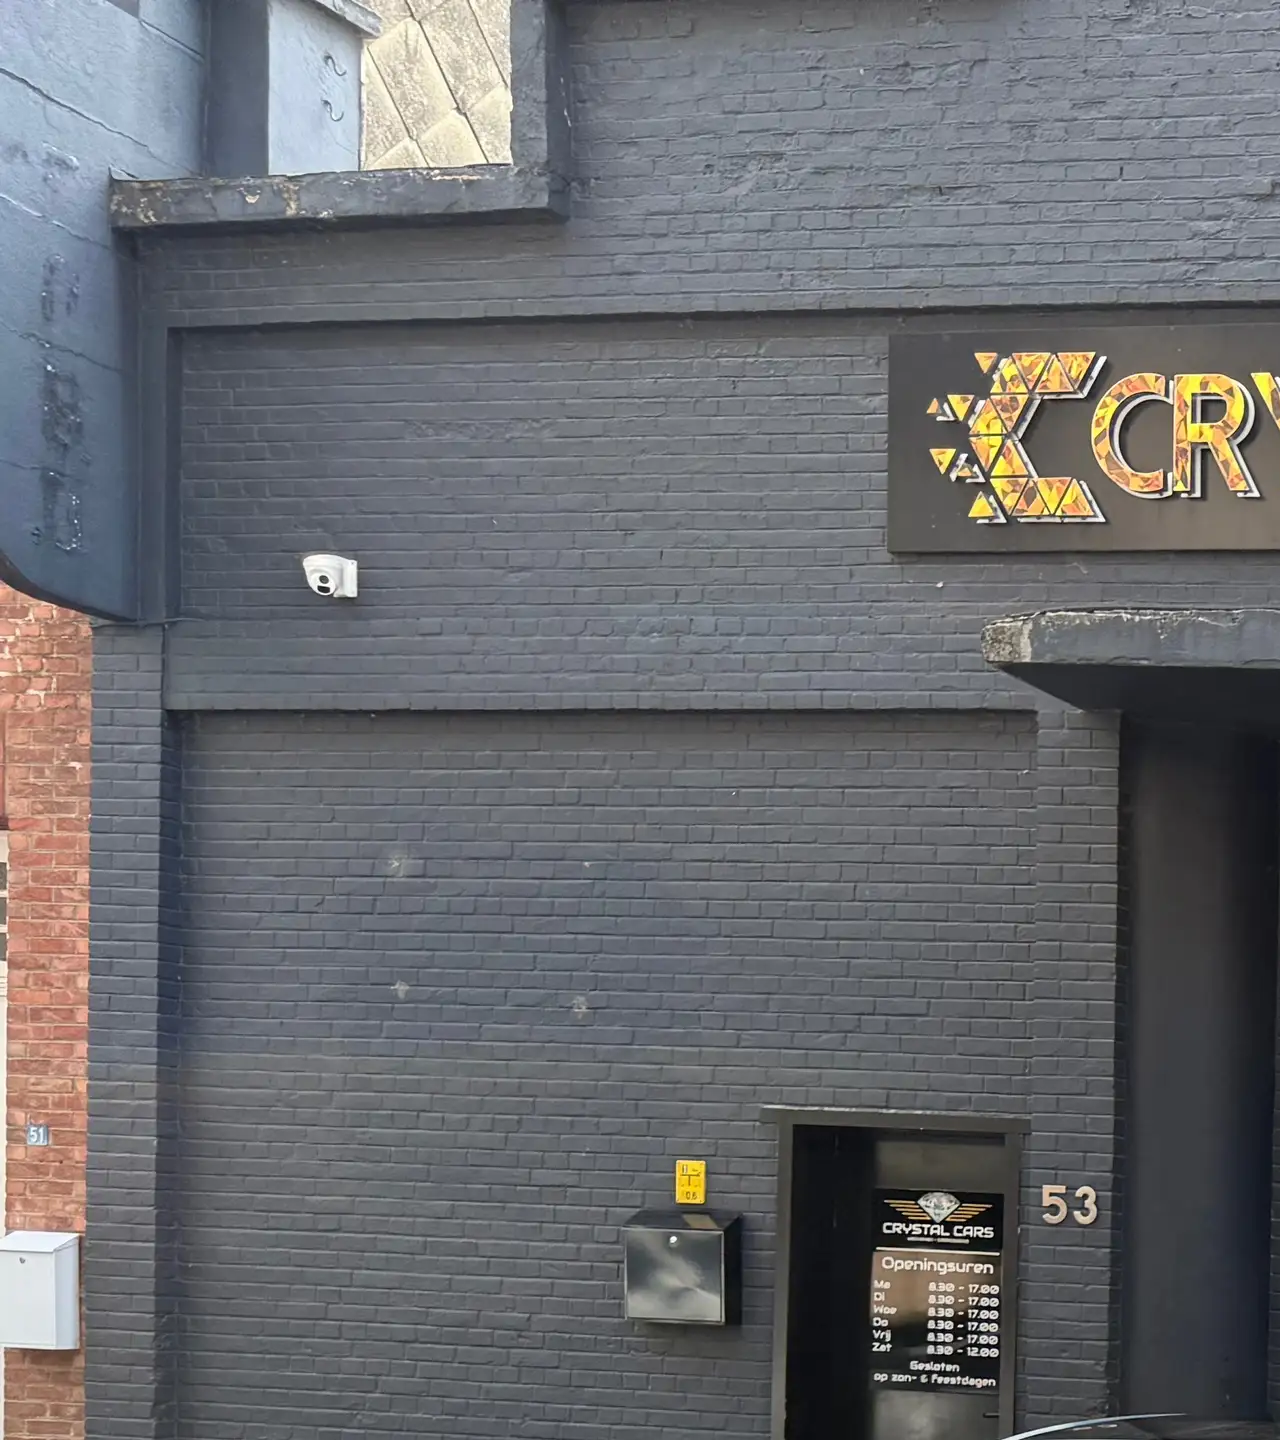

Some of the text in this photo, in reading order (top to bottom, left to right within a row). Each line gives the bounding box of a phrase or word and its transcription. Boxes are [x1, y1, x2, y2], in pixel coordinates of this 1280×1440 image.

[30, 1126, 44, 1143] 51
[1042, 1185, 1098, 1225] 53
[882, 1222, 994, 1239] CRYSTAL CARS
[881, 1256, 994, 1275] Openingsuren
[968, 1284, 1000, 1295] 17.00
[968, 1296, 1000, 1307] 17.00
[967, 1309, 999, 1320] 17.00
[872, 1317, 889, 1327] Do
[967, 1321, 999, 1333] 17.00
[872, 1329, 892, 1342] Vrij
[967, 1334, 999, 1345] 17.00
[966, 1347, 999, 1358] 12.00
[909, 1360, 960, 1372] Gesloten
[873, 1373, 888, 1382] op
